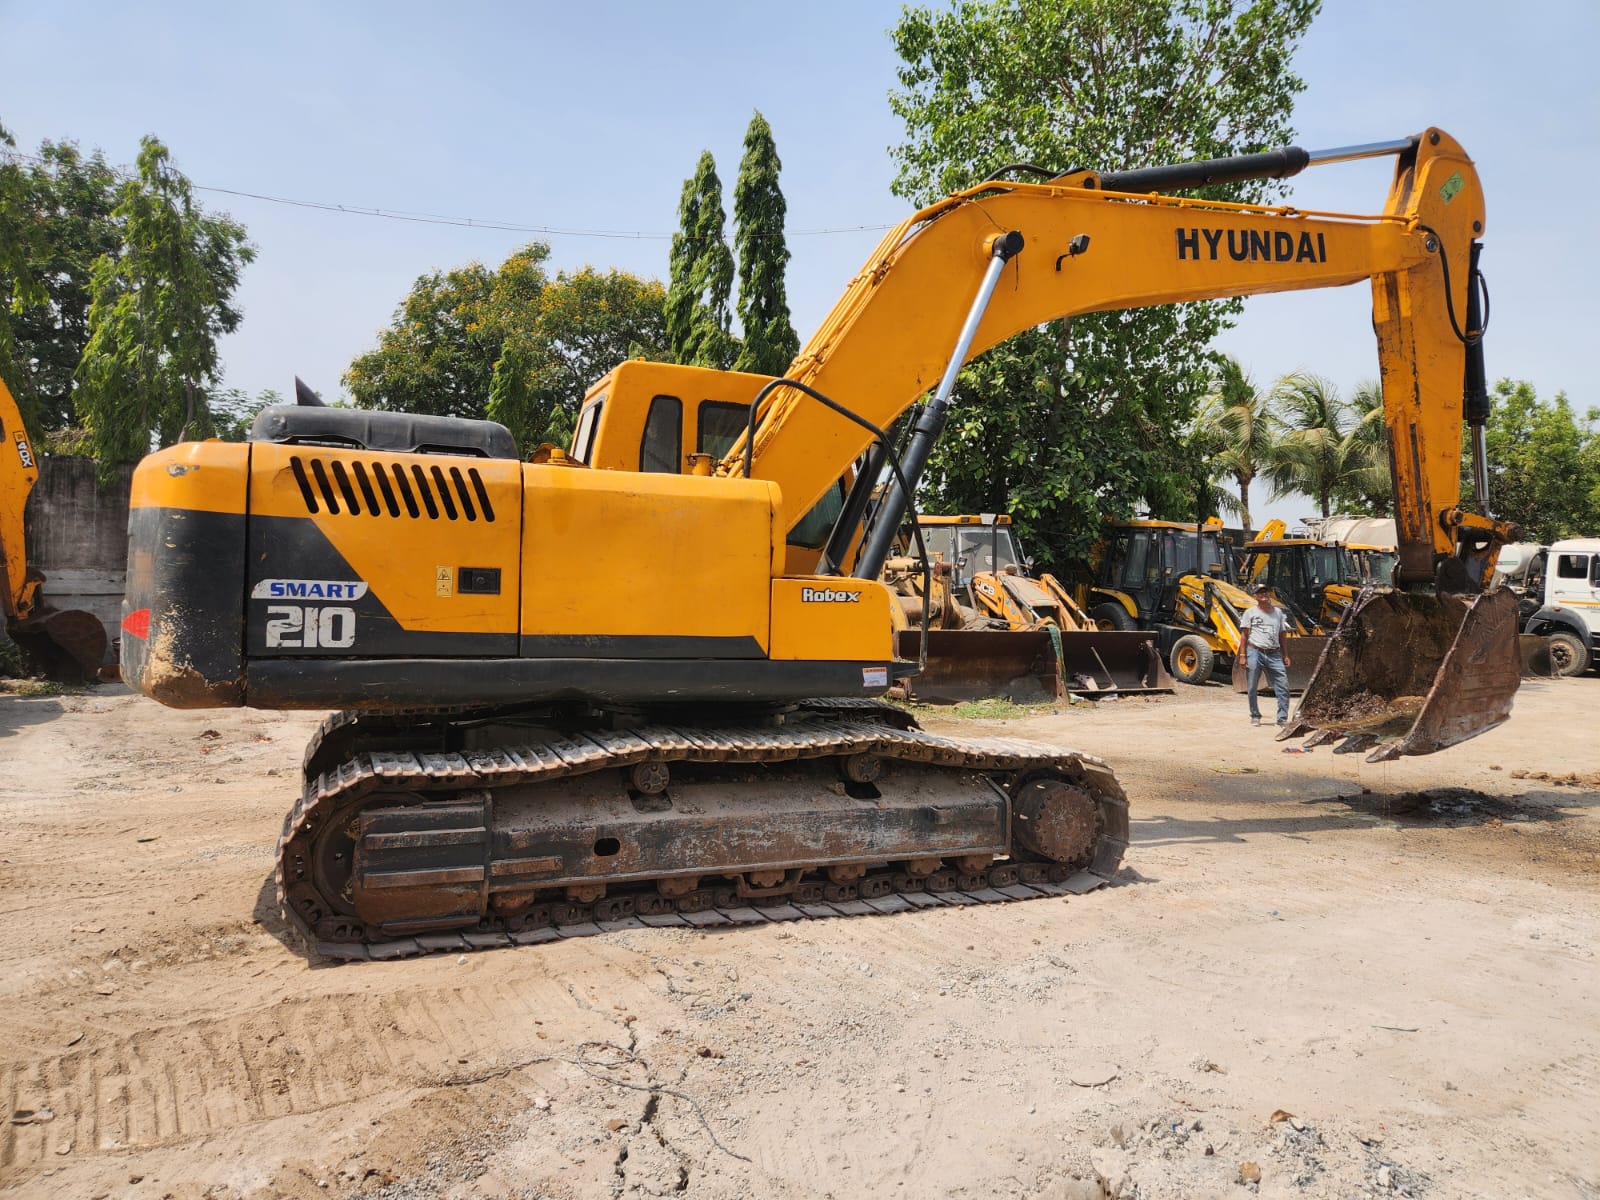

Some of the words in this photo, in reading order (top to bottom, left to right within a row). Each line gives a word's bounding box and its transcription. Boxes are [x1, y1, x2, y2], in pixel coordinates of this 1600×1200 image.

[1176, 228, 1326, 263] HYUNDAI
[270, 582, 358, 598] SMART
[802, 588, 861, 602] Robex
[266, 605, 356, 648] 210
